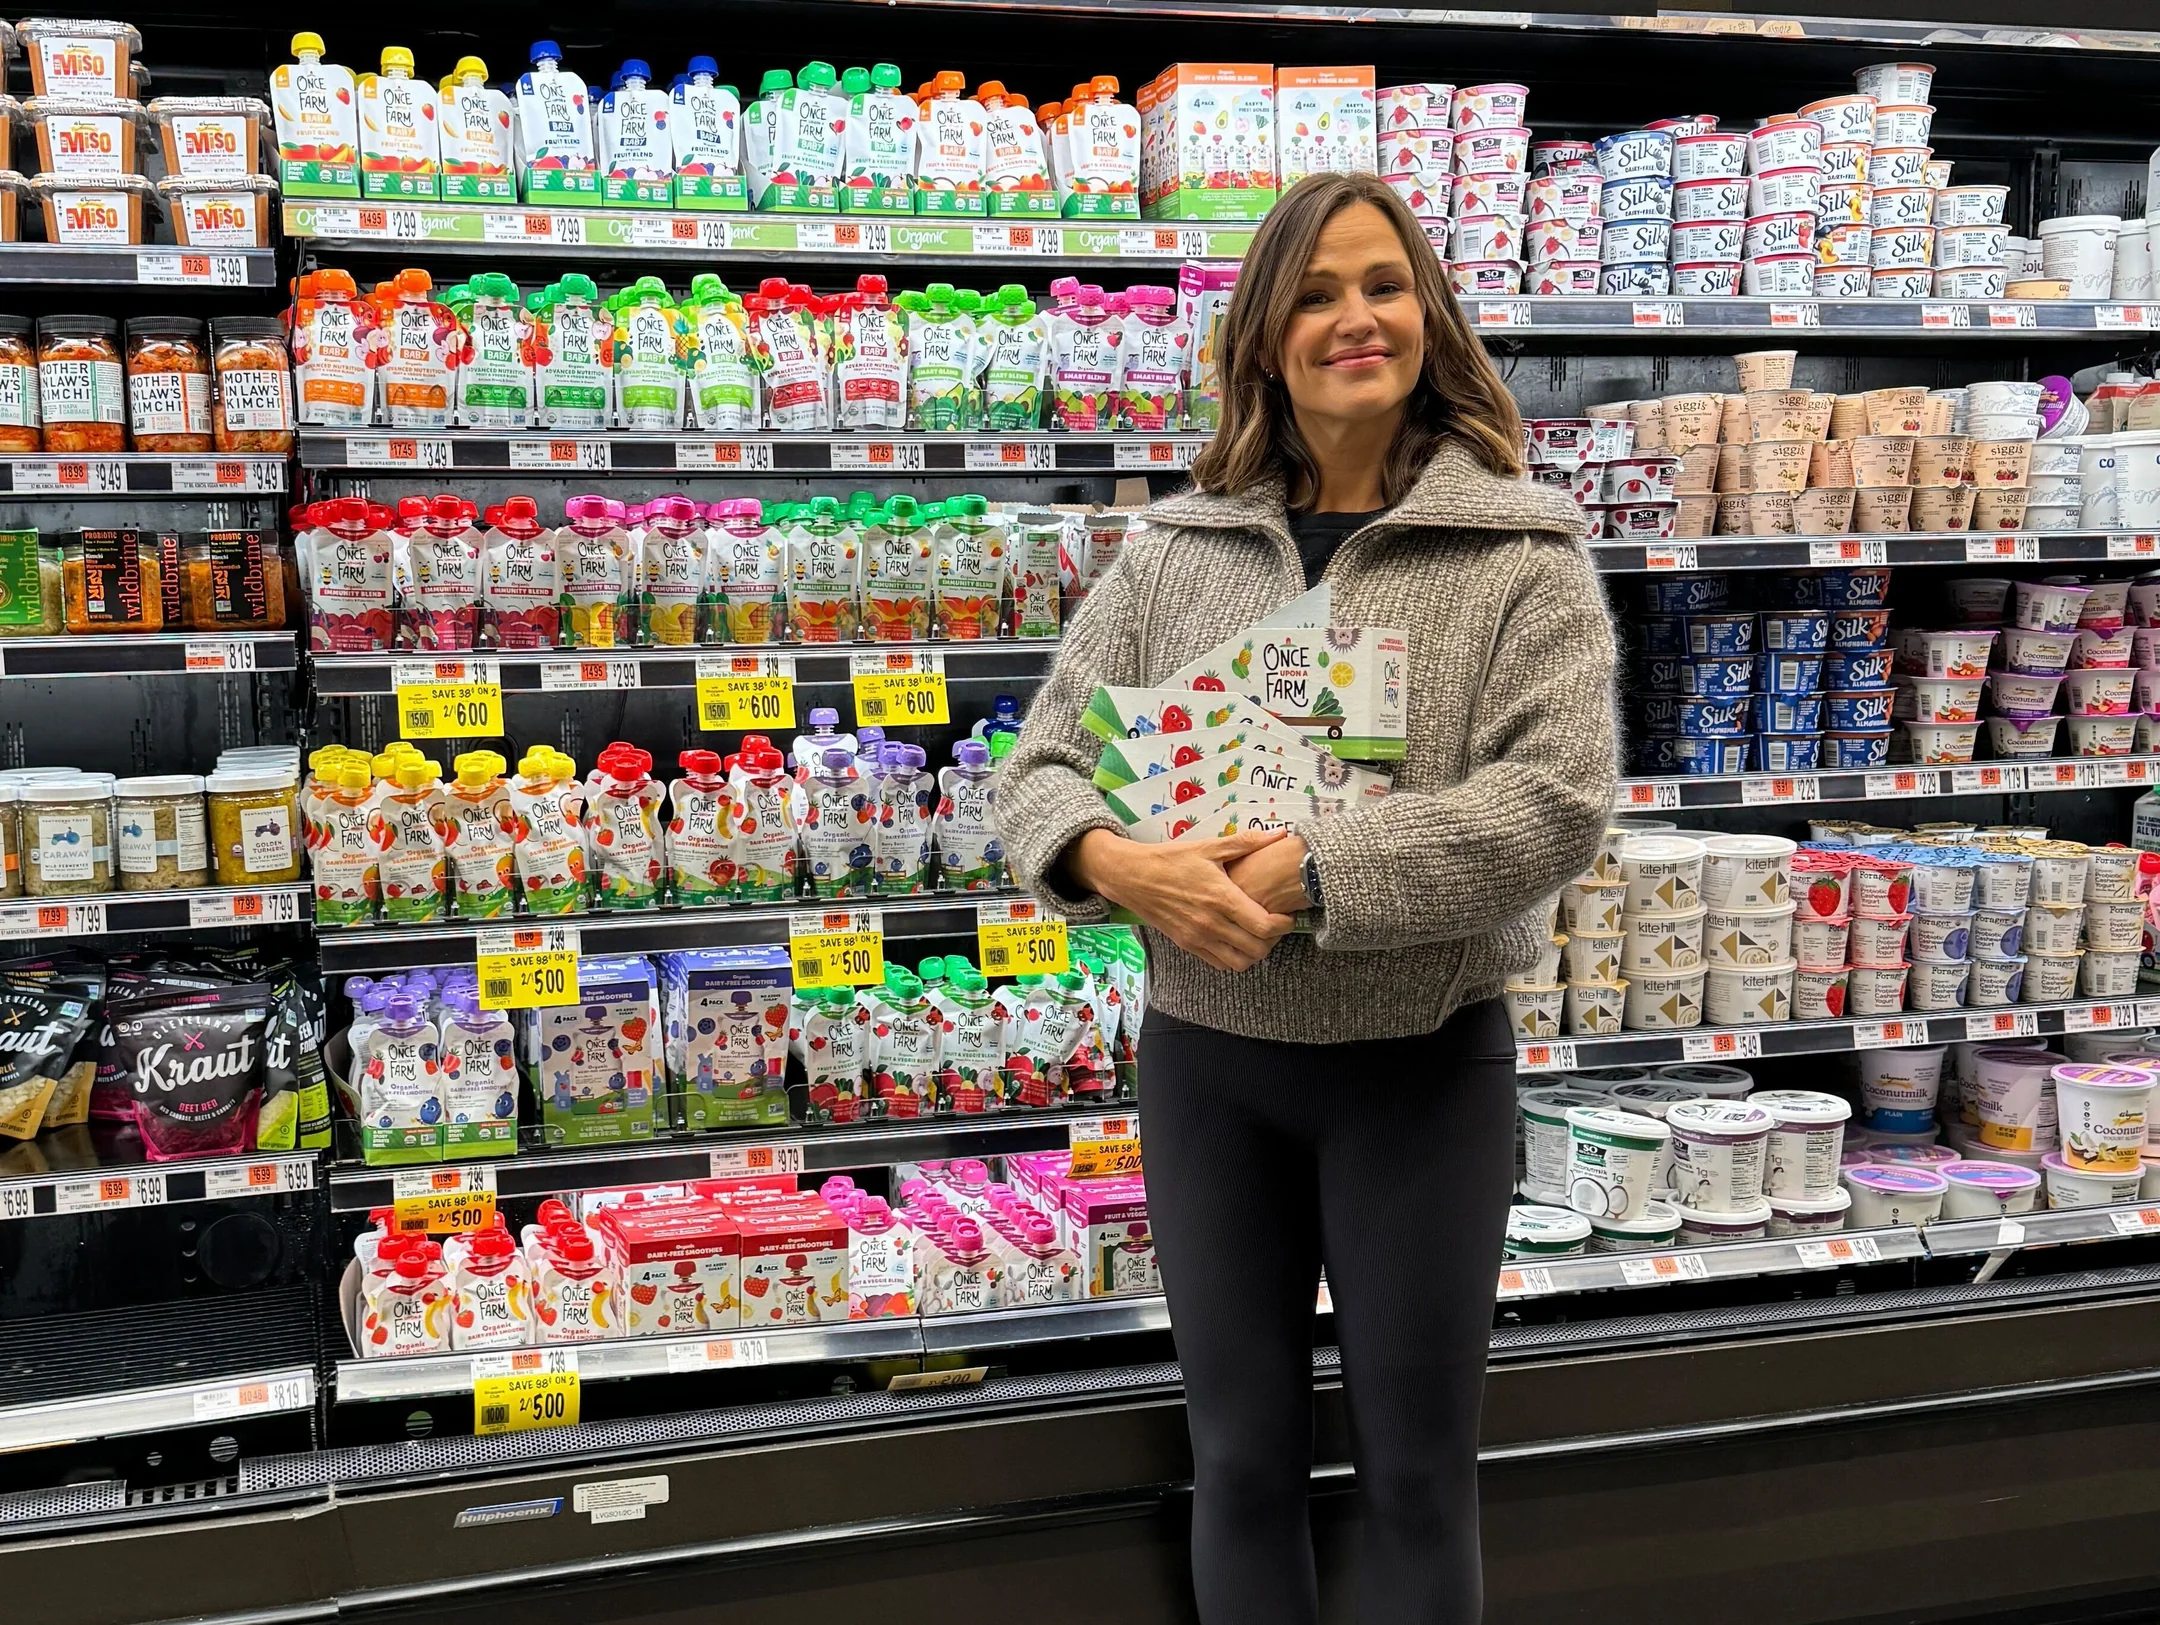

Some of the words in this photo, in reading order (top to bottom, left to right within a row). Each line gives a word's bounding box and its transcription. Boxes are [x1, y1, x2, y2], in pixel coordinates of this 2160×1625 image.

[297, 76, 325, 91] ONCE
[540, 84, 563, 99] ONCE
[299, 93, 329, 113] FARM
[545, 102, 570, 121] FARM
[800, 103, 826, 121] ONCE
[869, 104, 894, 121] ONCE
[937, 111, 963, 124] ONCE
[552, 122, 572, 131] BABY
[1091, 114, 1117, 128] ONCE
[800, 123, 824, 141] FARM
[869, 123, 893, 142] FARM
[939, 125, 964, 145] FARM
[1093, 129, 1118, 147] FARM
[1823, 151, 1856, 175] Silk
[1891, 155, 1924, 177] Silk
[1618, 183, 1653, 211] Silk
[1764, 221, 1797, 247] Silk
[1892, 235, 1925, 257] Silk
[1606, 271, 1638, 295] Silk
[321, 311, 350, 327] ONCE
[561, 315, 588, 330] ONCE
[858, 314, 885, 328] ONCE
[320, 329, 348, 346] FARM
[563, 333, 588, 352] FARM
[860, 330, 886, 345] FARM
[1073, 332, 1100, 344] ONCE
[323, 347, 346, 356] BABY
[566, 352, 589, 362] BABY
[1073, 347, 1099, 365] FARM
[130, 376, 180, 387] MOTHER
[224, 372, 278, 384] MOTHER
[132, 401, 182, 413] KIMCHI
[226, 397, 281, 409] KIMCHI
[337, 545, 367, 560] ONCE
[733, 544, 760, 558] ONCE
[885, 540, 911, 556] ONCE
[19, 533, 41, 620] wildbrine
[118, 533, 140, 619] wildbrine
[244, 534, 265, 618] wildbrine
[338, 565, 365, 583] FARM
[734, 562, 759, 579] FARM
[886, 560, 911, 577] FARM
[162, 537, 180, 620] wildbrine
[1846, 576, 1882, 600] Silk
[1832, 620, 1867, 641] Silk
[1264, 643, 1310, 670] ONCE
[432, 690, 455, 698] SAVE
[1266, 672, 1309, 707] FARM
[1699, 704, 1736, 728] Silk
[822, 794, 848, 808] ONCE
[959, 787, 985, 800] ONCE
[691, 798, 716, 812] ONCE
[959, 804, 984, 821] FARM
[463, 806, 492, 821] ONCE
[823, 810, 848, 828] FARM
[467, 824, 495, 841] FARM
[690, 815, 713, 834] FARM
[688, 835, 715, 843] Organic
[44, 850, 89, 859] CARAWAY
[1639, 864, 1661, 875] kite
[1663, 863, 1676, 874] hill
[1638, 922, 1661, 933] kite
[1661, 922, 1675, 932] hill
[511, 957, 535, 966] SAVE
[568, 954, 573, 962] 2
[1643, 979, 1665, 991] kite
[1666, 979, 1680, 990] hill
[701, 998, 708, 1007] 4
[958, 1013, 983, 1027] ONCE
[154, 1017, 231, 1040] CLEVELAND
[465, 1039, 492, 1054] ONCE
[958, 1030, 982, 1047] FARM
[134, 1034, 255, 1093] Kraut
[466, 1058, 491, 1074] FARM
[1865, 1084, 1928, 1098] Coconutmilk
[179, 1102, 199, 1113] BEET
[201, 1099, 218, 1110] RED
[797, 1240, 833, 1248] SMOOTHIES
[647, 1250, 683, 1258] DAIRY-FREE
[685, 1247, 722, 1255] SMOOTHIES
[642, 1272, 650, 1281] 4
[954, 1270, 981, 1285] ONCE
[1027, 1263, 1054, 1278] ONCE
[477, 1284, 505, 1298] ONCE
[562, 1286, 590, 1302] ONCE
[955, 1289, 981, 1307] FARM
[1028, 1282, 1053, 1300] FARM
[394, 1302, 421, 1318] ONCE
[480, 1303, 508, 1319] FARM
[563, 1304, 588, 1324] FARM
[395, 1320, 422, 1337] FARM
[509, 1380, 532, 1391] SAVE
[555, 1376, 566, 1384] ON
[569, 1377, 574, 1386] 2
[461, 1506, 551, 1524] Hillphoenix
